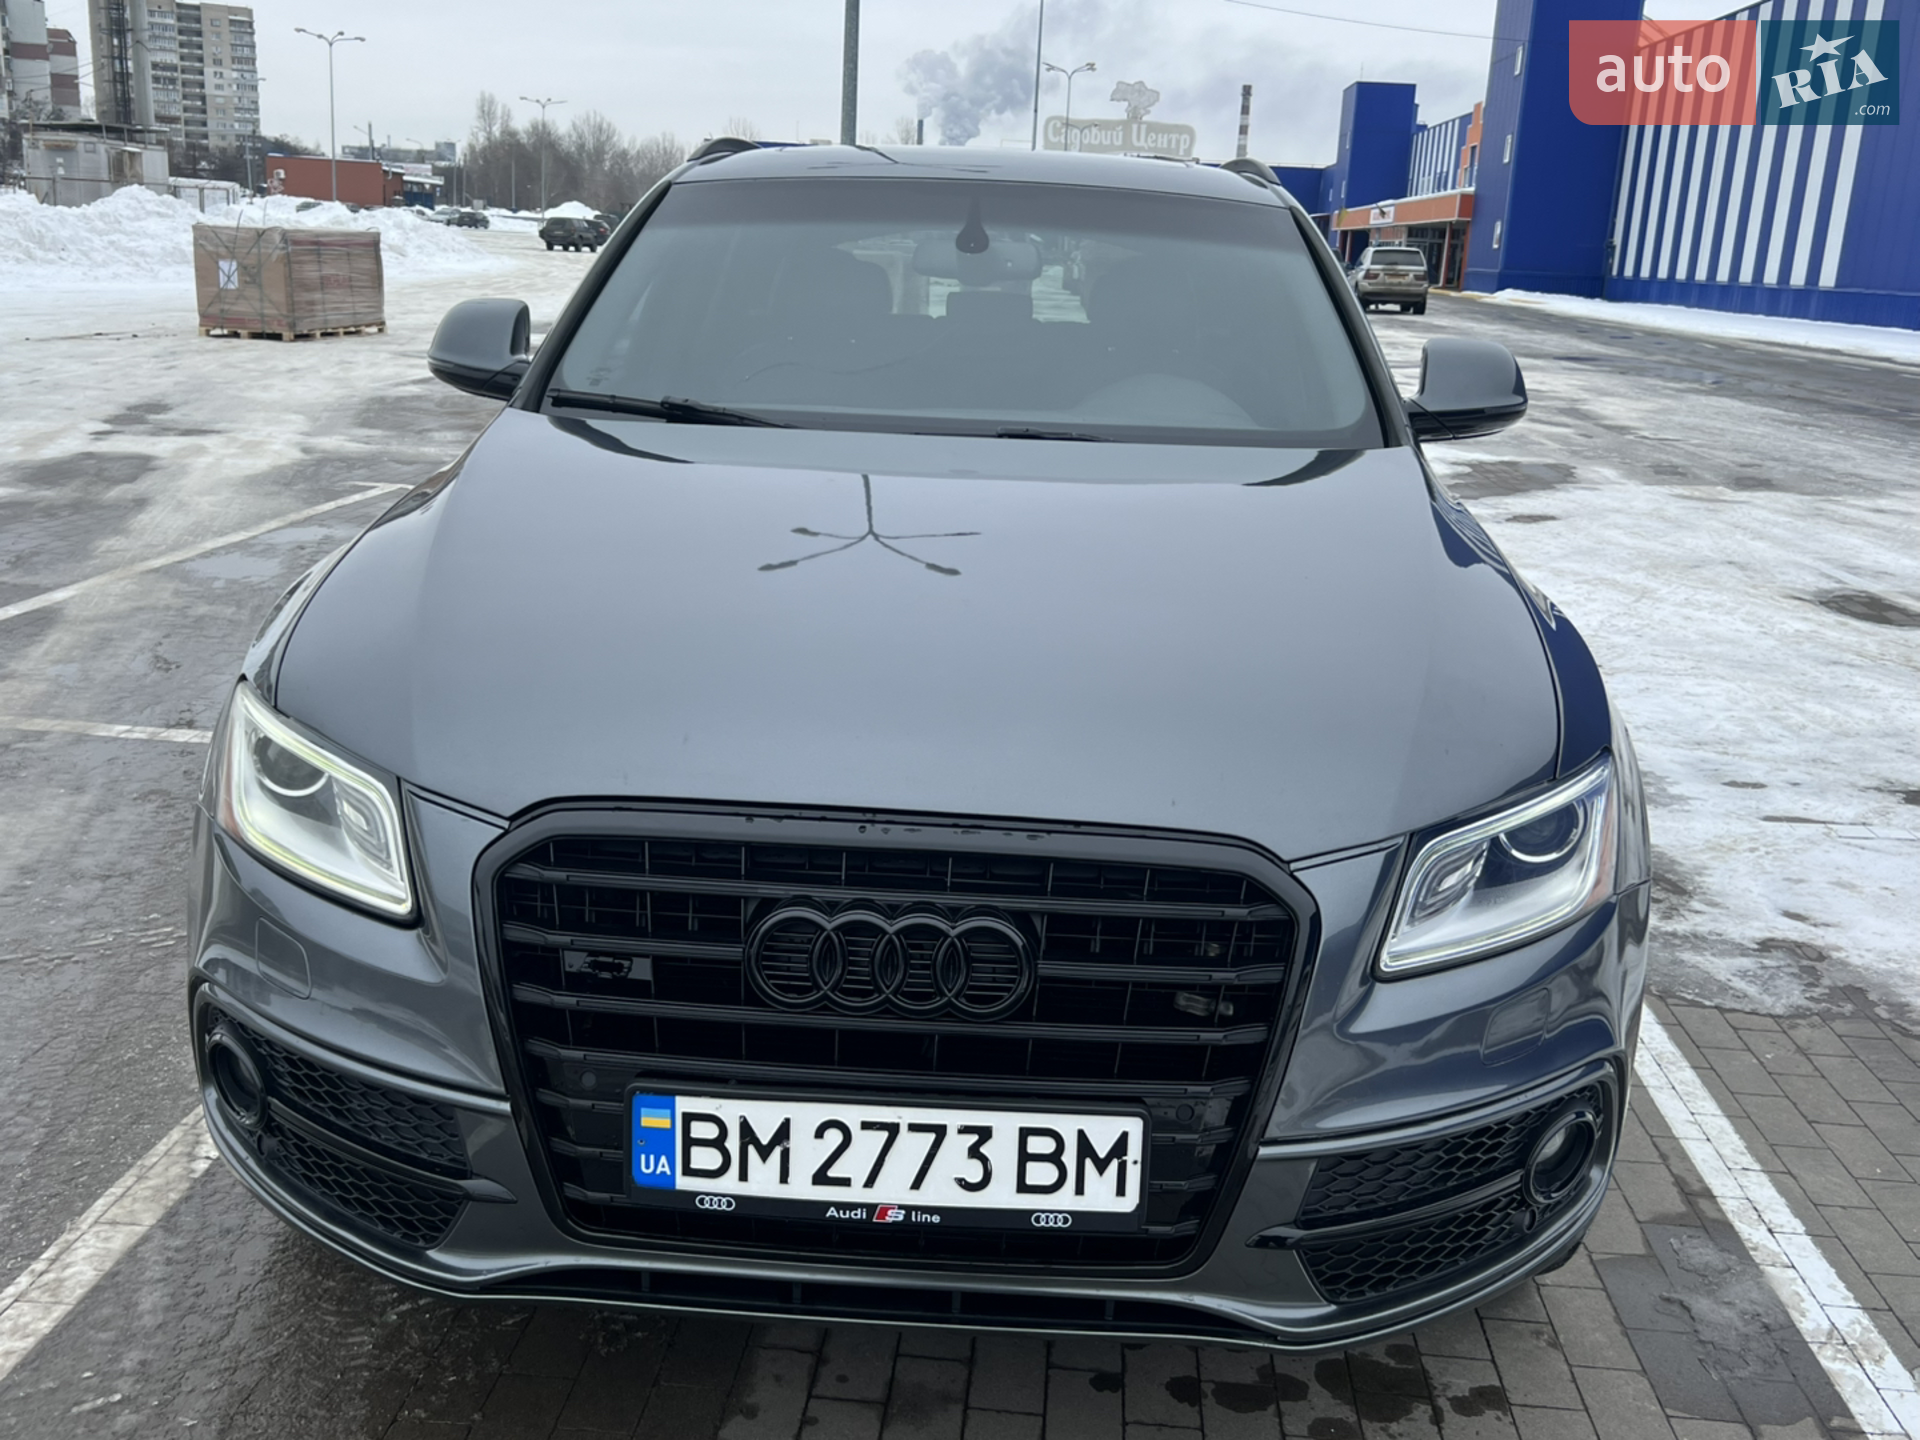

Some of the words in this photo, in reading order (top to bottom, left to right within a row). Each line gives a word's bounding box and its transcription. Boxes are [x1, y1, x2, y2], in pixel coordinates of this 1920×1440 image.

[1047, 119, 1123, 151] Садовий
[1131, 123, 1190, 155] Центр
[640, 1153, 672, 1176] UA
[681, 1111, 791, 1184] BM
[812, 1119, 993, 1192] 2773
[1016, 1126, 1129, 1198] BM
[825, 1206, 867, 1220] Audi
[911, 1210, 941, 1224] line
